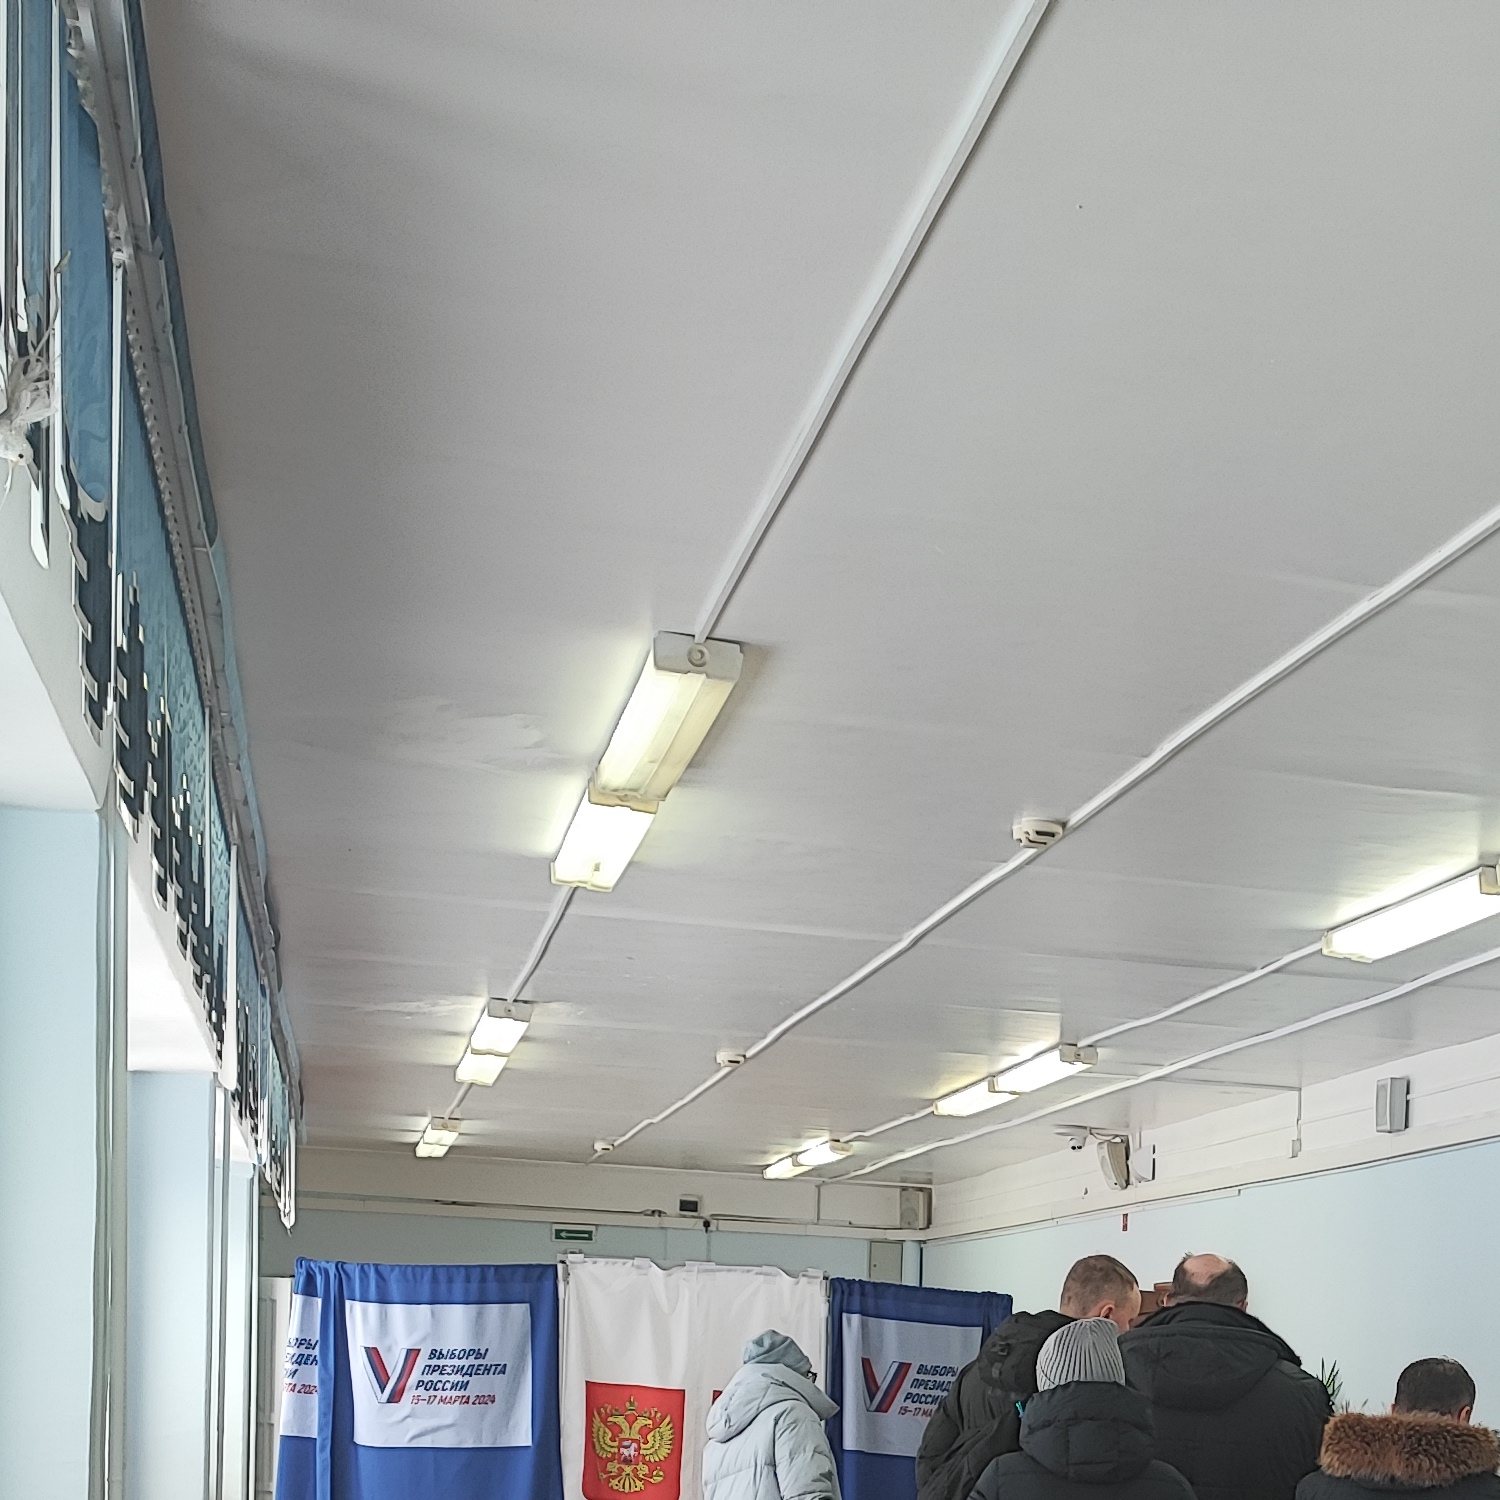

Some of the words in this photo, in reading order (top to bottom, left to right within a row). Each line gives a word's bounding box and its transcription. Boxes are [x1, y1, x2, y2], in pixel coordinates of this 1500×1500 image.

[427, 1348, 489, 1360] ВЫБОРЫ
[421, 1363, 508, 1377] ПРЕЗИДЕНТА
[916, 1364, 959, 1377] ВЫБОРЫ
[415, 1380, 470, 1392] РОССИИ
[438, 1395, 470, 1405] МАРТА
[472, 1394, 496, 1405] 2024
